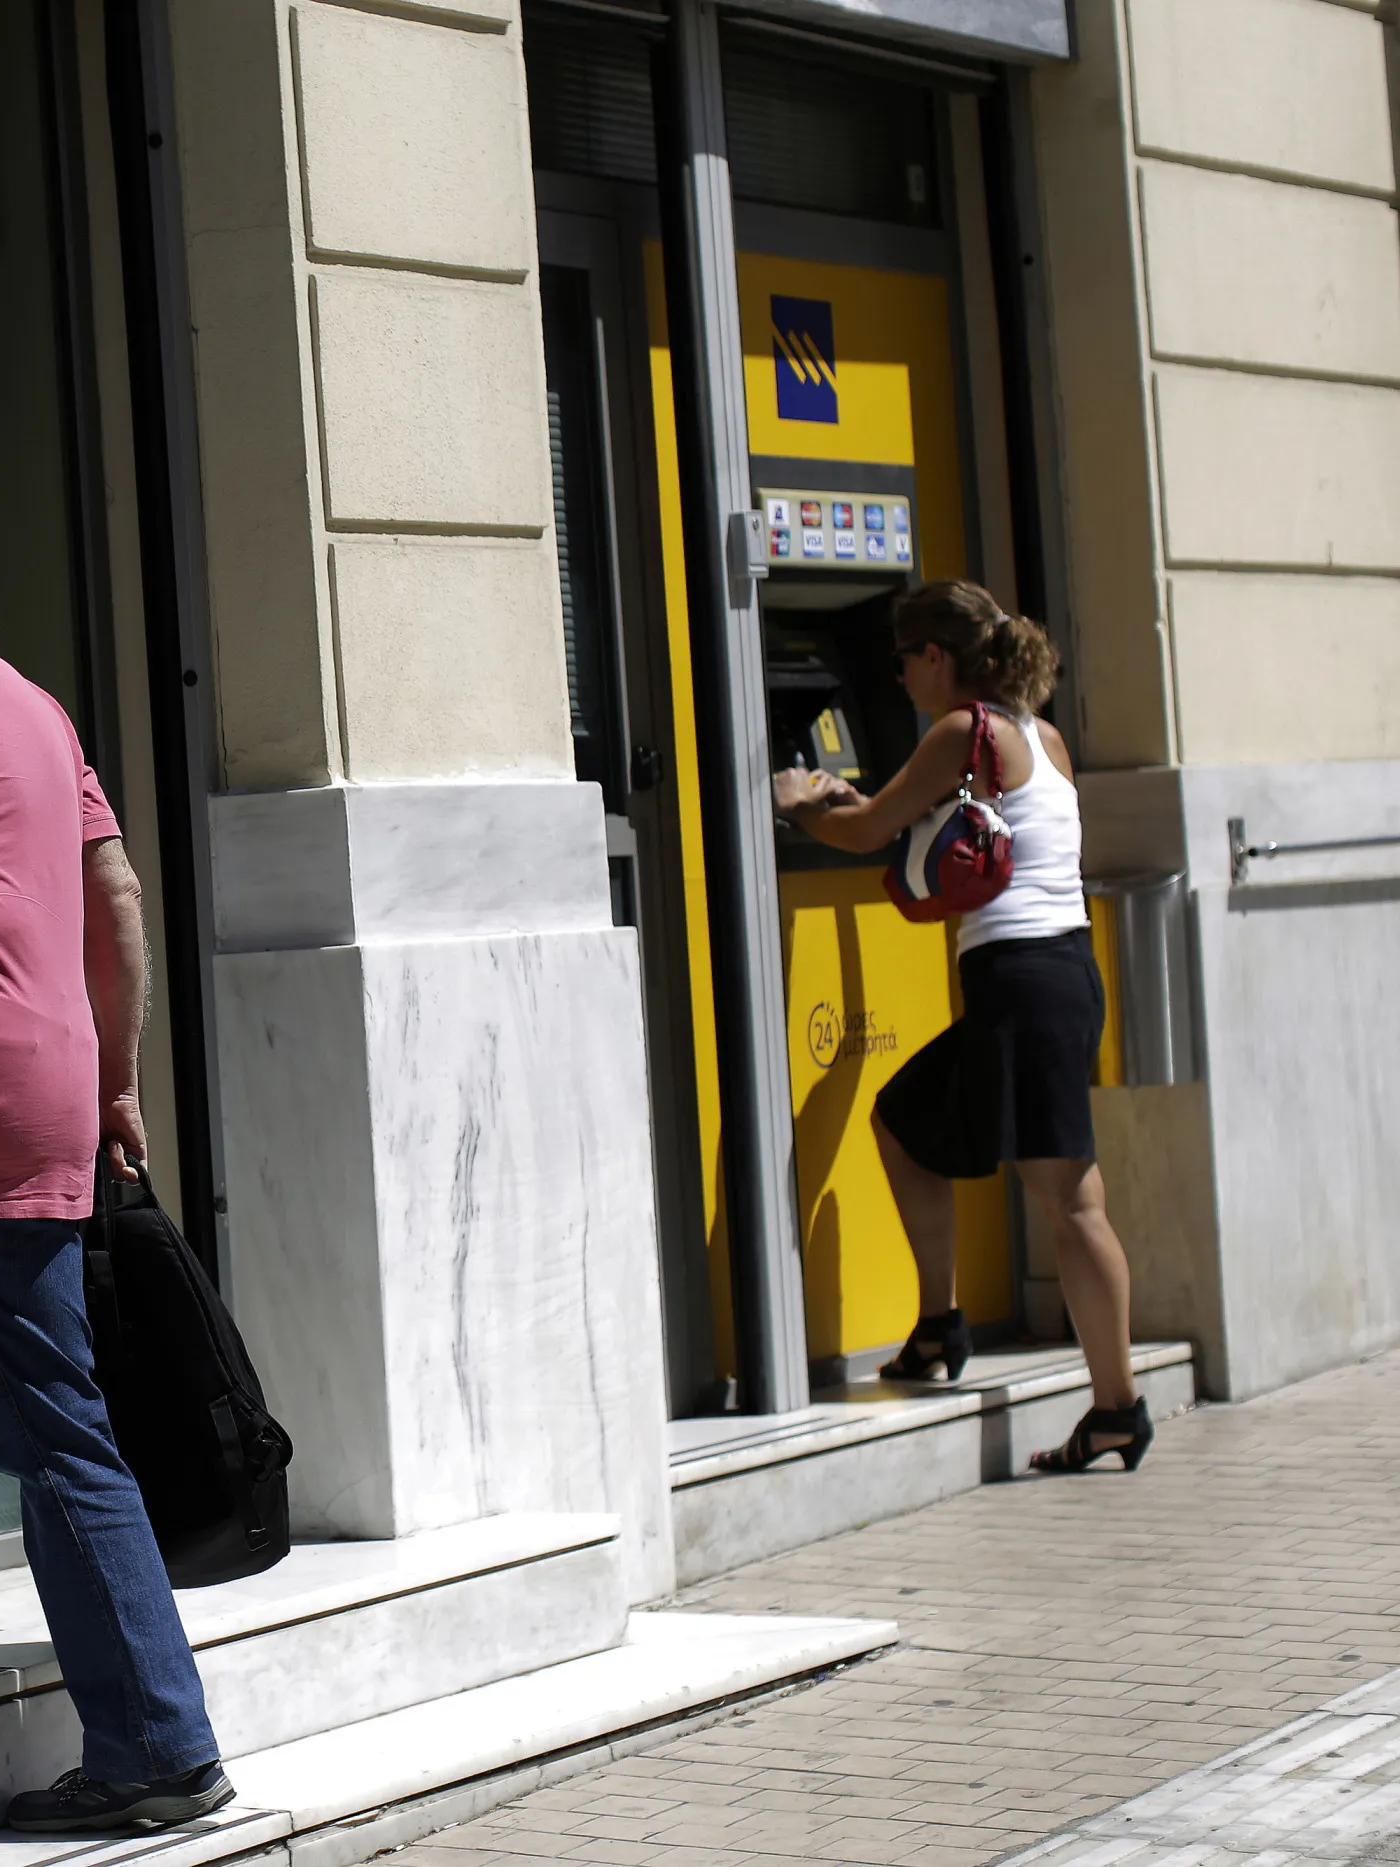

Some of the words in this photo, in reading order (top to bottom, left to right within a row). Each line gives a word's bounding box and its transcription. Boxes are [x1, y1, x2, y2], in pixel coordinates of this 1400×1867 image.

[806, 534, 823, 547] VISA
[838, 536, 855, 549] VISA
[814, 1020, 833, 1051] 24
